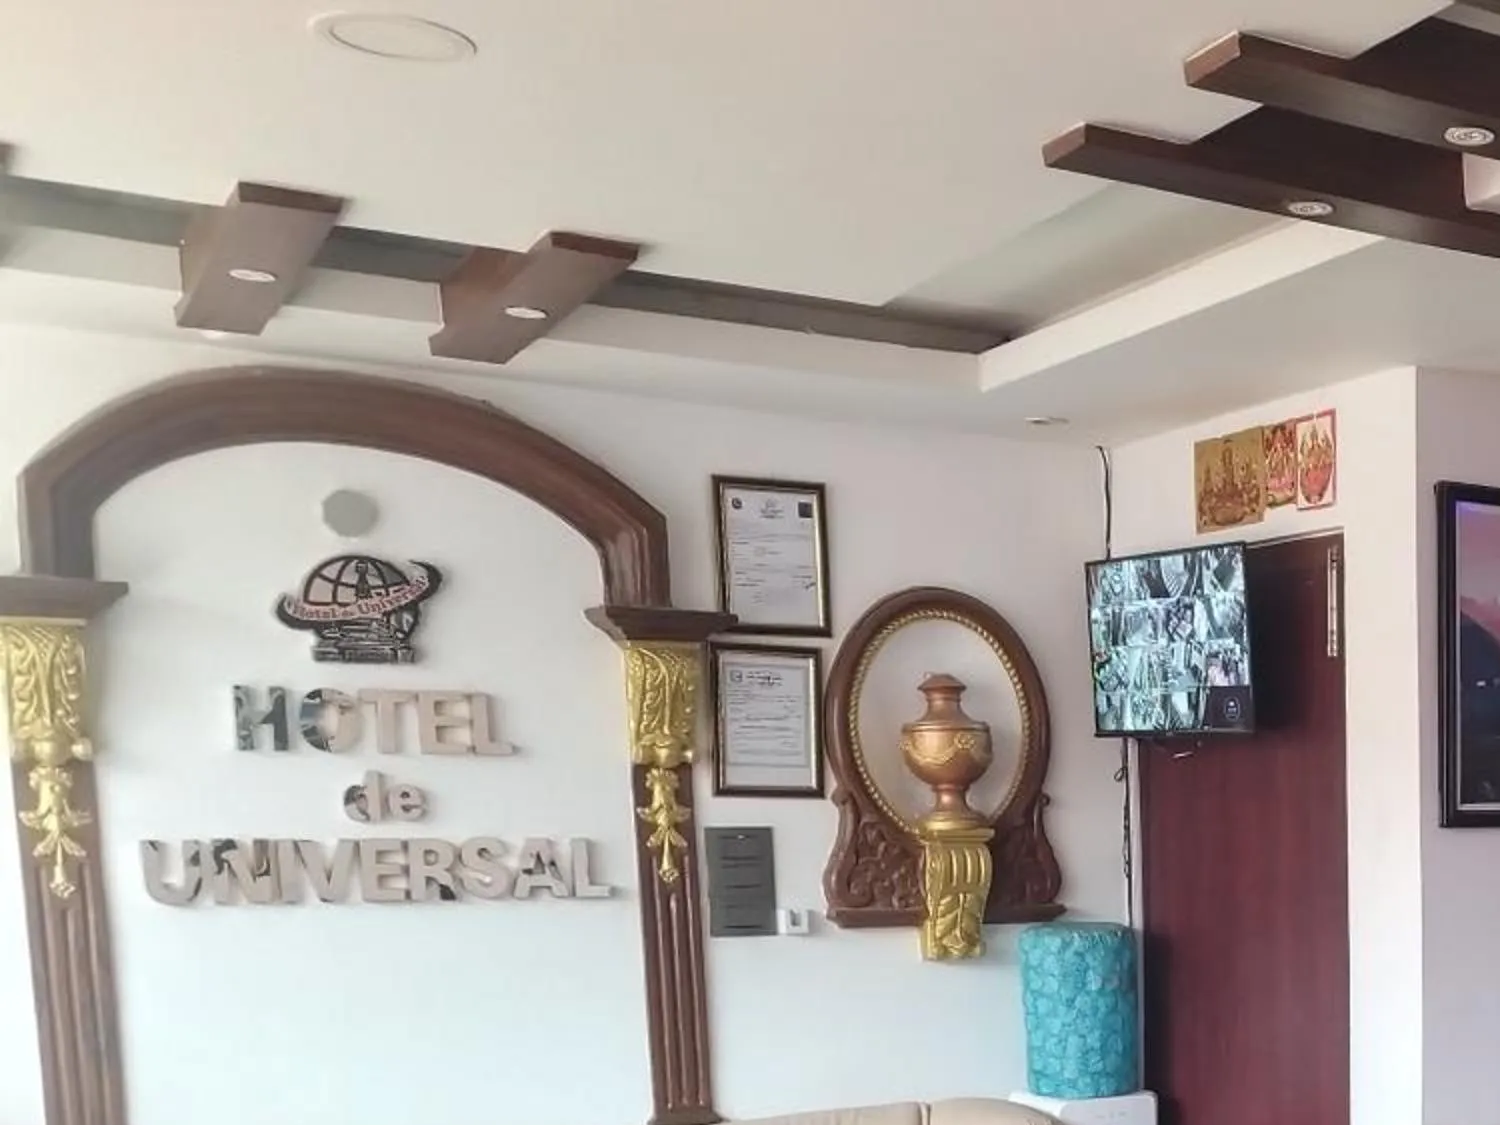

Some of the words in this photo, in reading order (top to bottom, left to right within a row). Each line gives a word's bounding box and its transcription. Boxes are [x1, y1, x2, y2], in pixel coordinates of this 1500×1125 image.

[232, 684, 518, 755] HOTEL
[344, 770, 430, 822] de
[141, 837, 615, 904] UNIVERSAL
